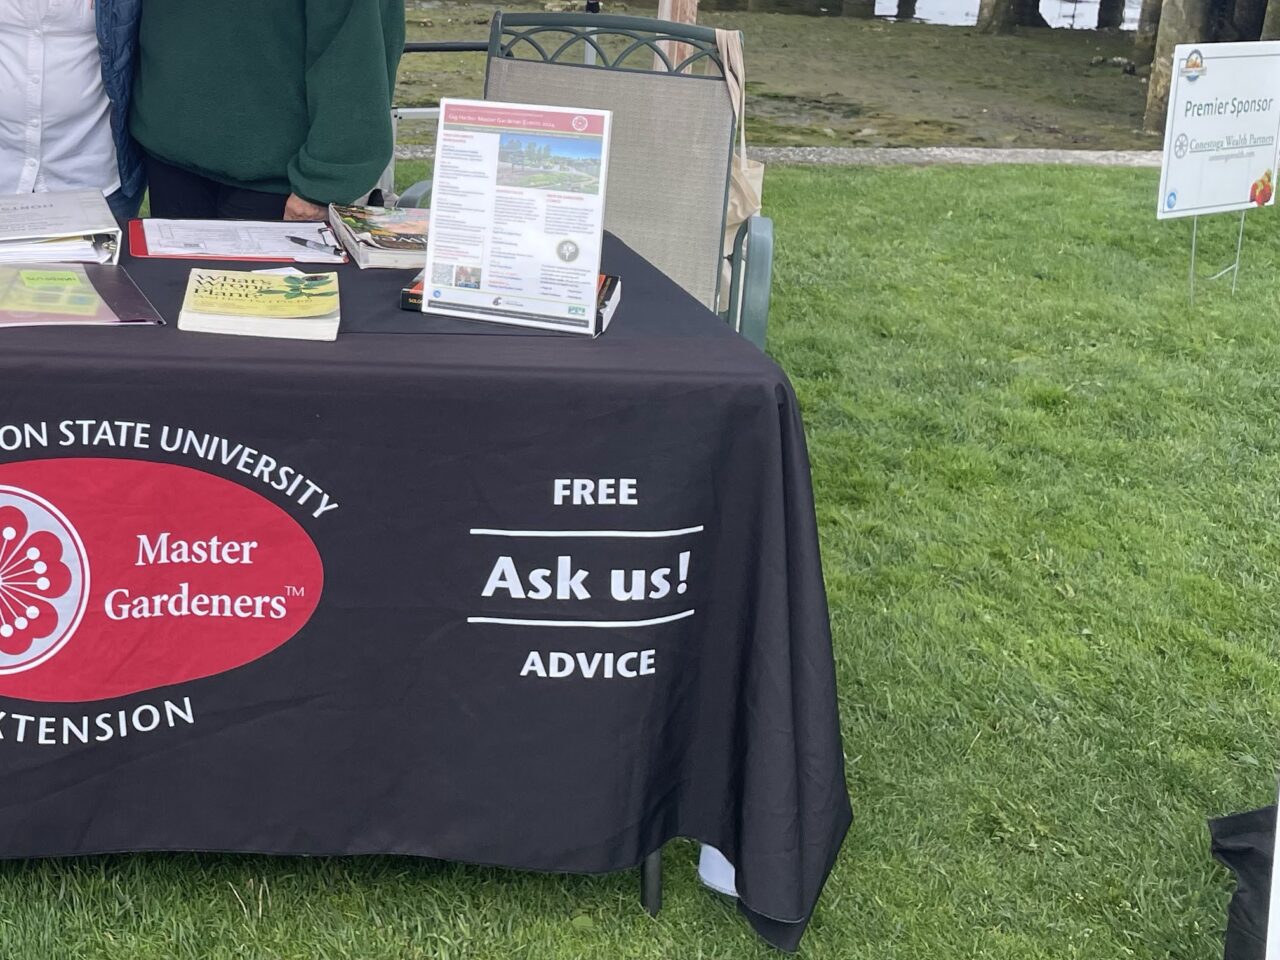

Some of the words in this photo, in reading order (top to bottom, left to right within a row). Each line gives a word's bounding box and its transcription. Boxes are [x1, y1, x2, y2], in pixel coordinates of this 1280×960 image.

[1184, 97, 1229, 118] Premier
[1230, 96, 1274, 118] Sponsor
[1189, 138, 1224, 151] Conestoga
[1226, 134, 1248, 147] Wealth
[1249, 134, 1274, 145] Partners
[58, 420, 150, 449] STATE
[160, 426, 338, 519] UNIVERSITY
[553, 478, 638, 506] FREE
[134, 532, 258, 566] Master
[481, 555, 592, 600] Ask
[611, 550, 691, 601] us!
[519, 649, 656, 679] ADVICE
